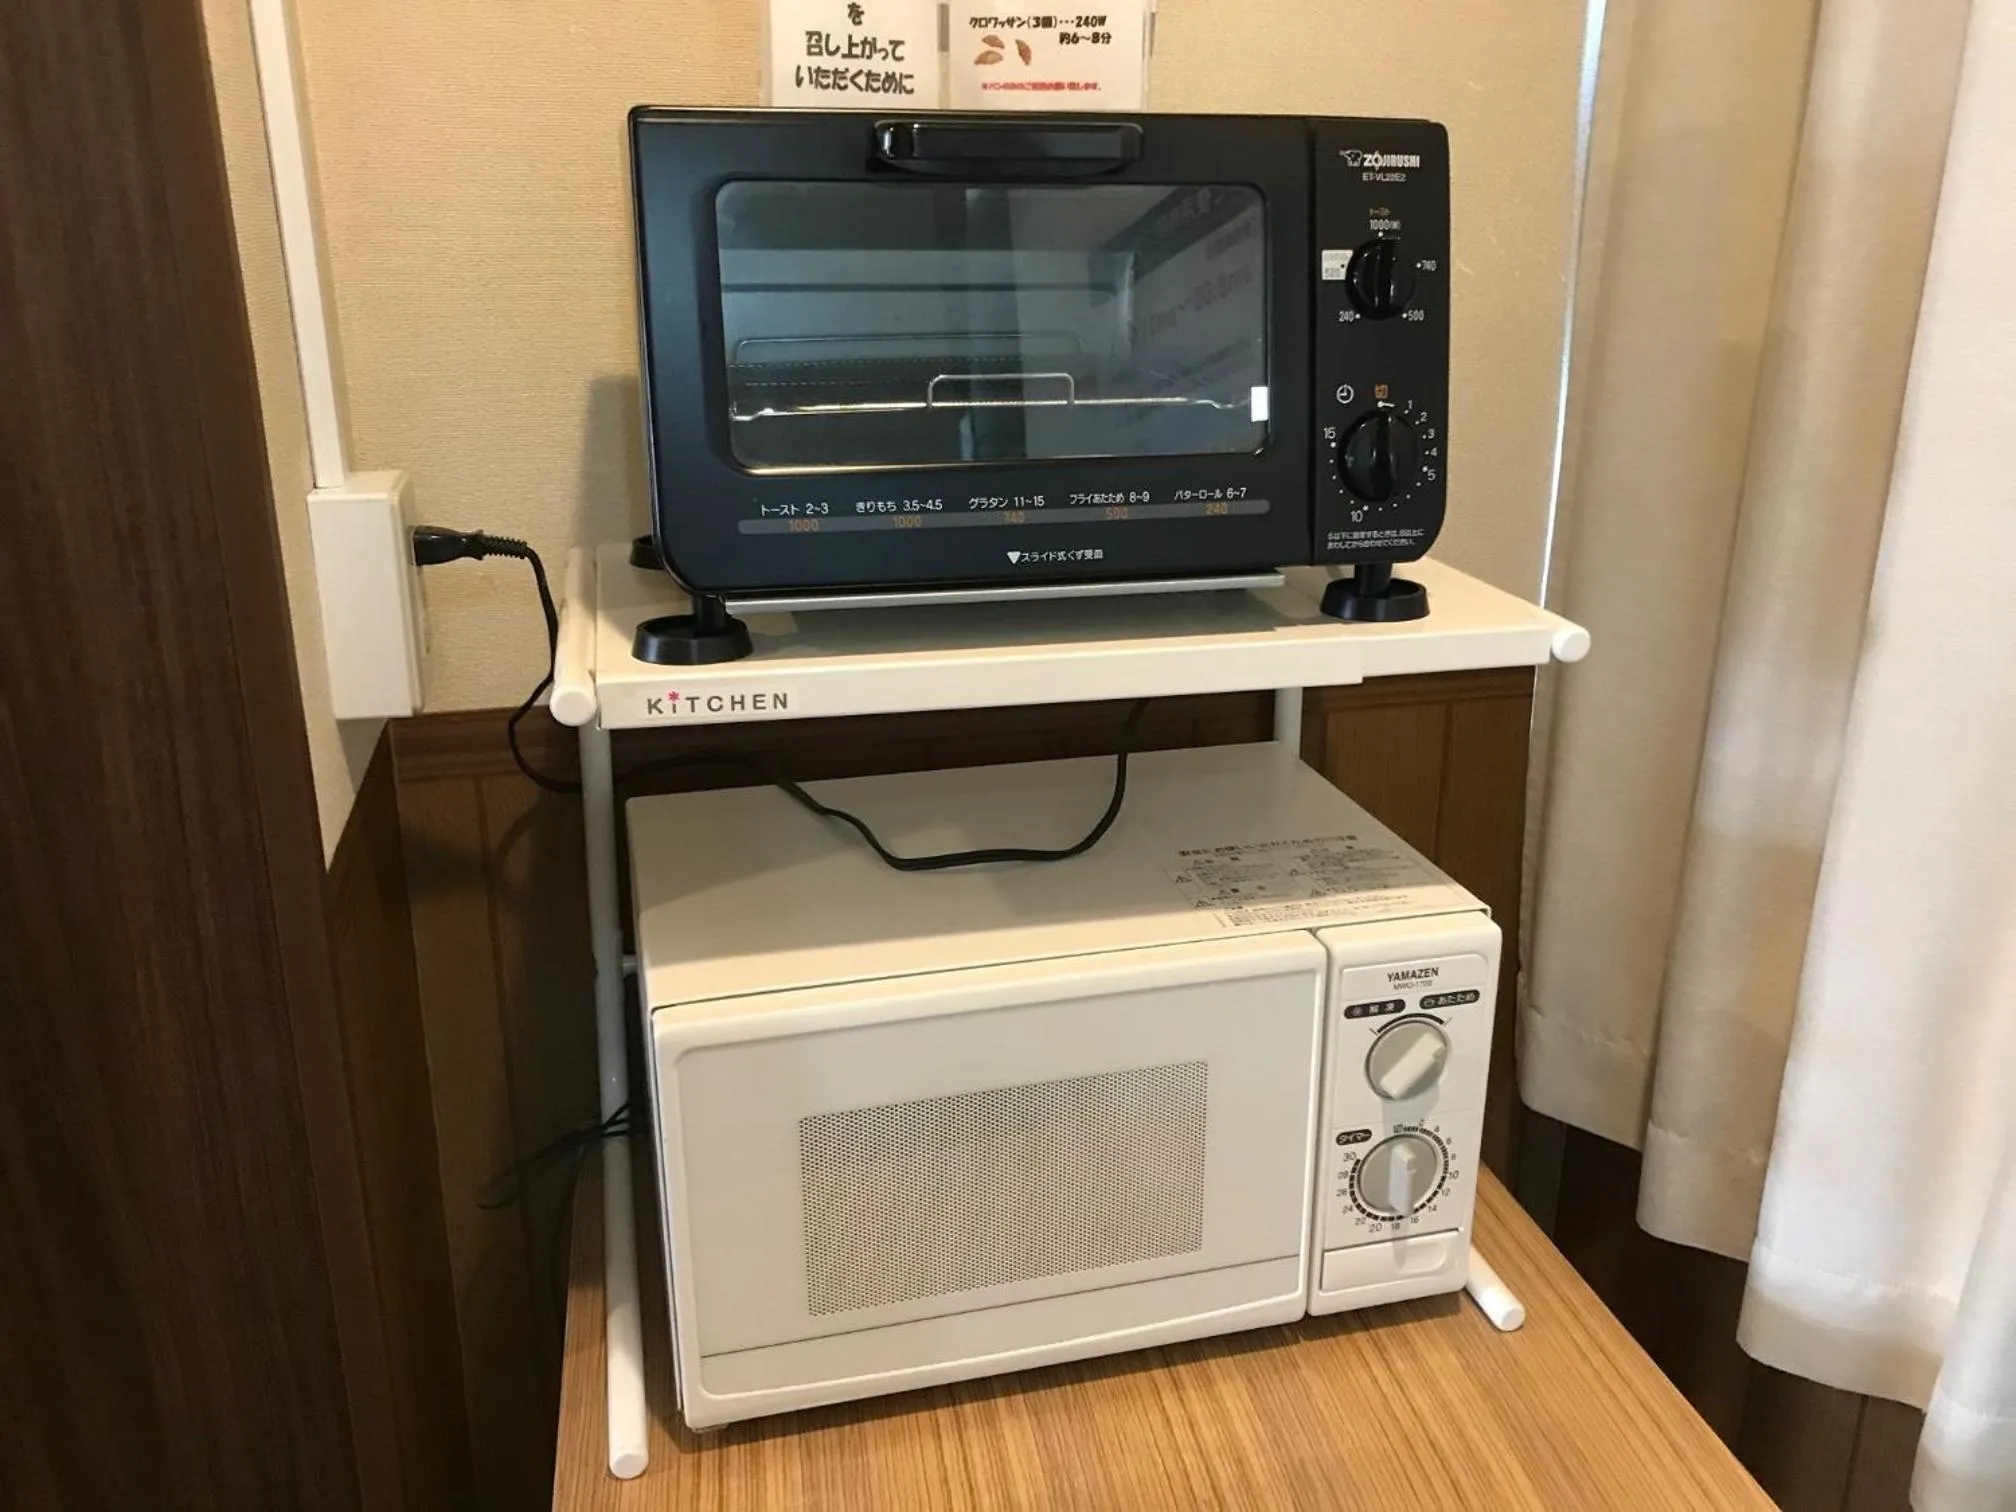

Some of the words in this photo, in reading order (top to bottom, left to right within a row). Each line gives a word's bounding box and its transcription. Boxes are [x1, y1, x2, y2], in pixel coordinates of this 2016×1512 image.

[847, 2, 864, 26] を
[805, 31, 905, 62] 召し上がって
[795, 65, 915, 95] いただくために
[1422, 260, 1437, 272] 740
[1339, 311, 1355, 322] 240
[1408, 310, 1425, 321] 500
[1408, 400, 1413, 409] 1
[1420, 412, 1427, 422] 2
[1323, 427, 1336, 439] 15
[1428, 429, 1435, 439] 3
[1430, 448, 1438, 457] 4
[1427, 469, 1436, 481] 5
[1070, 493, 1125, 505] フライあたため
[1175, 489, 1223, 500] バターロール
[855, 501, 897, 513] きりもち
[969, 497, 1008, 510] グラタン
[1204, 504, 1229, 515] 240
[761, 504, 799, 516] トースト
[1105, 508, 1128, 520] 500
[1351, 510, 1363, 522] 10
[788, 519, 819, 533] 1000
[892, 515, 922, 529] 1000
[1387, 967, 1439, 982] YAMAZEN
[1343, 1151, 1357, 1162] 30
[1448, 1170, 1459, 1180] 10
[1369, 1223, 1382, 1233] 20
